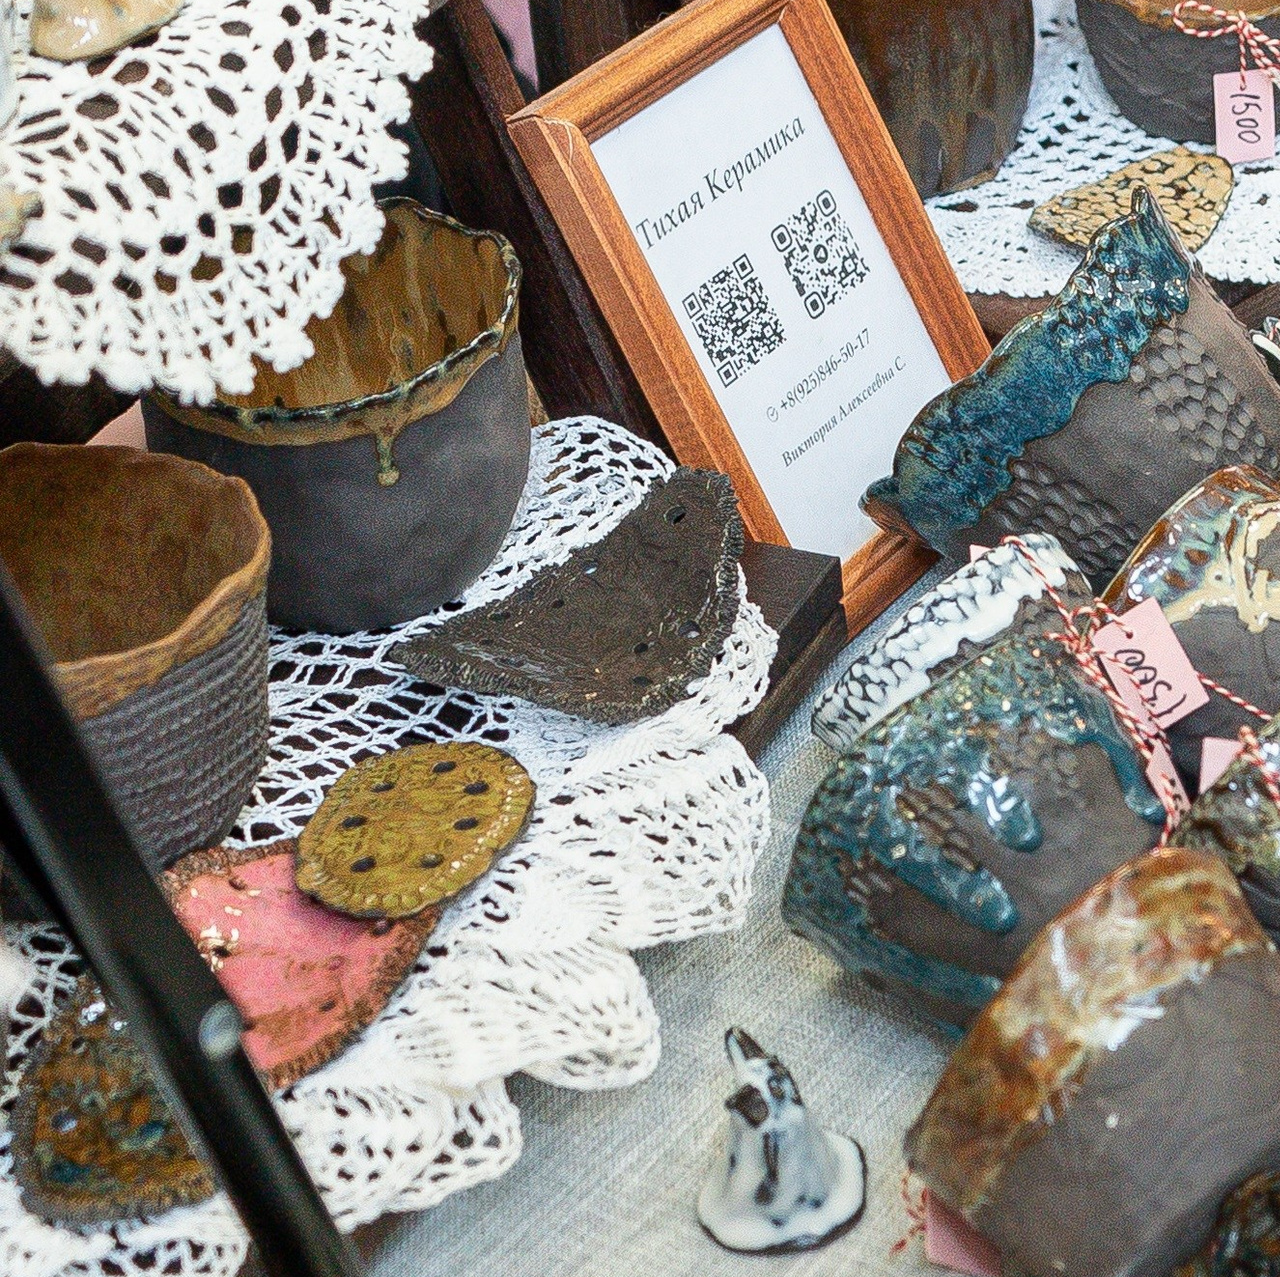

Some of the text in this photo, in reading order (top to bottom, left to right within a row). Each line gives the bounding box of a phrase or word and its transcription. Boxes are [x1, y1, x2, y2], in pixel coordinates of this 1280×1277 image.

[1230, 94, 1263, 144] 1500
[635, 114, 805, 251] Тихая Керамика
[781, 409, 842, 470] Виктория
[834, 364, 897, 428] Алексеевна
